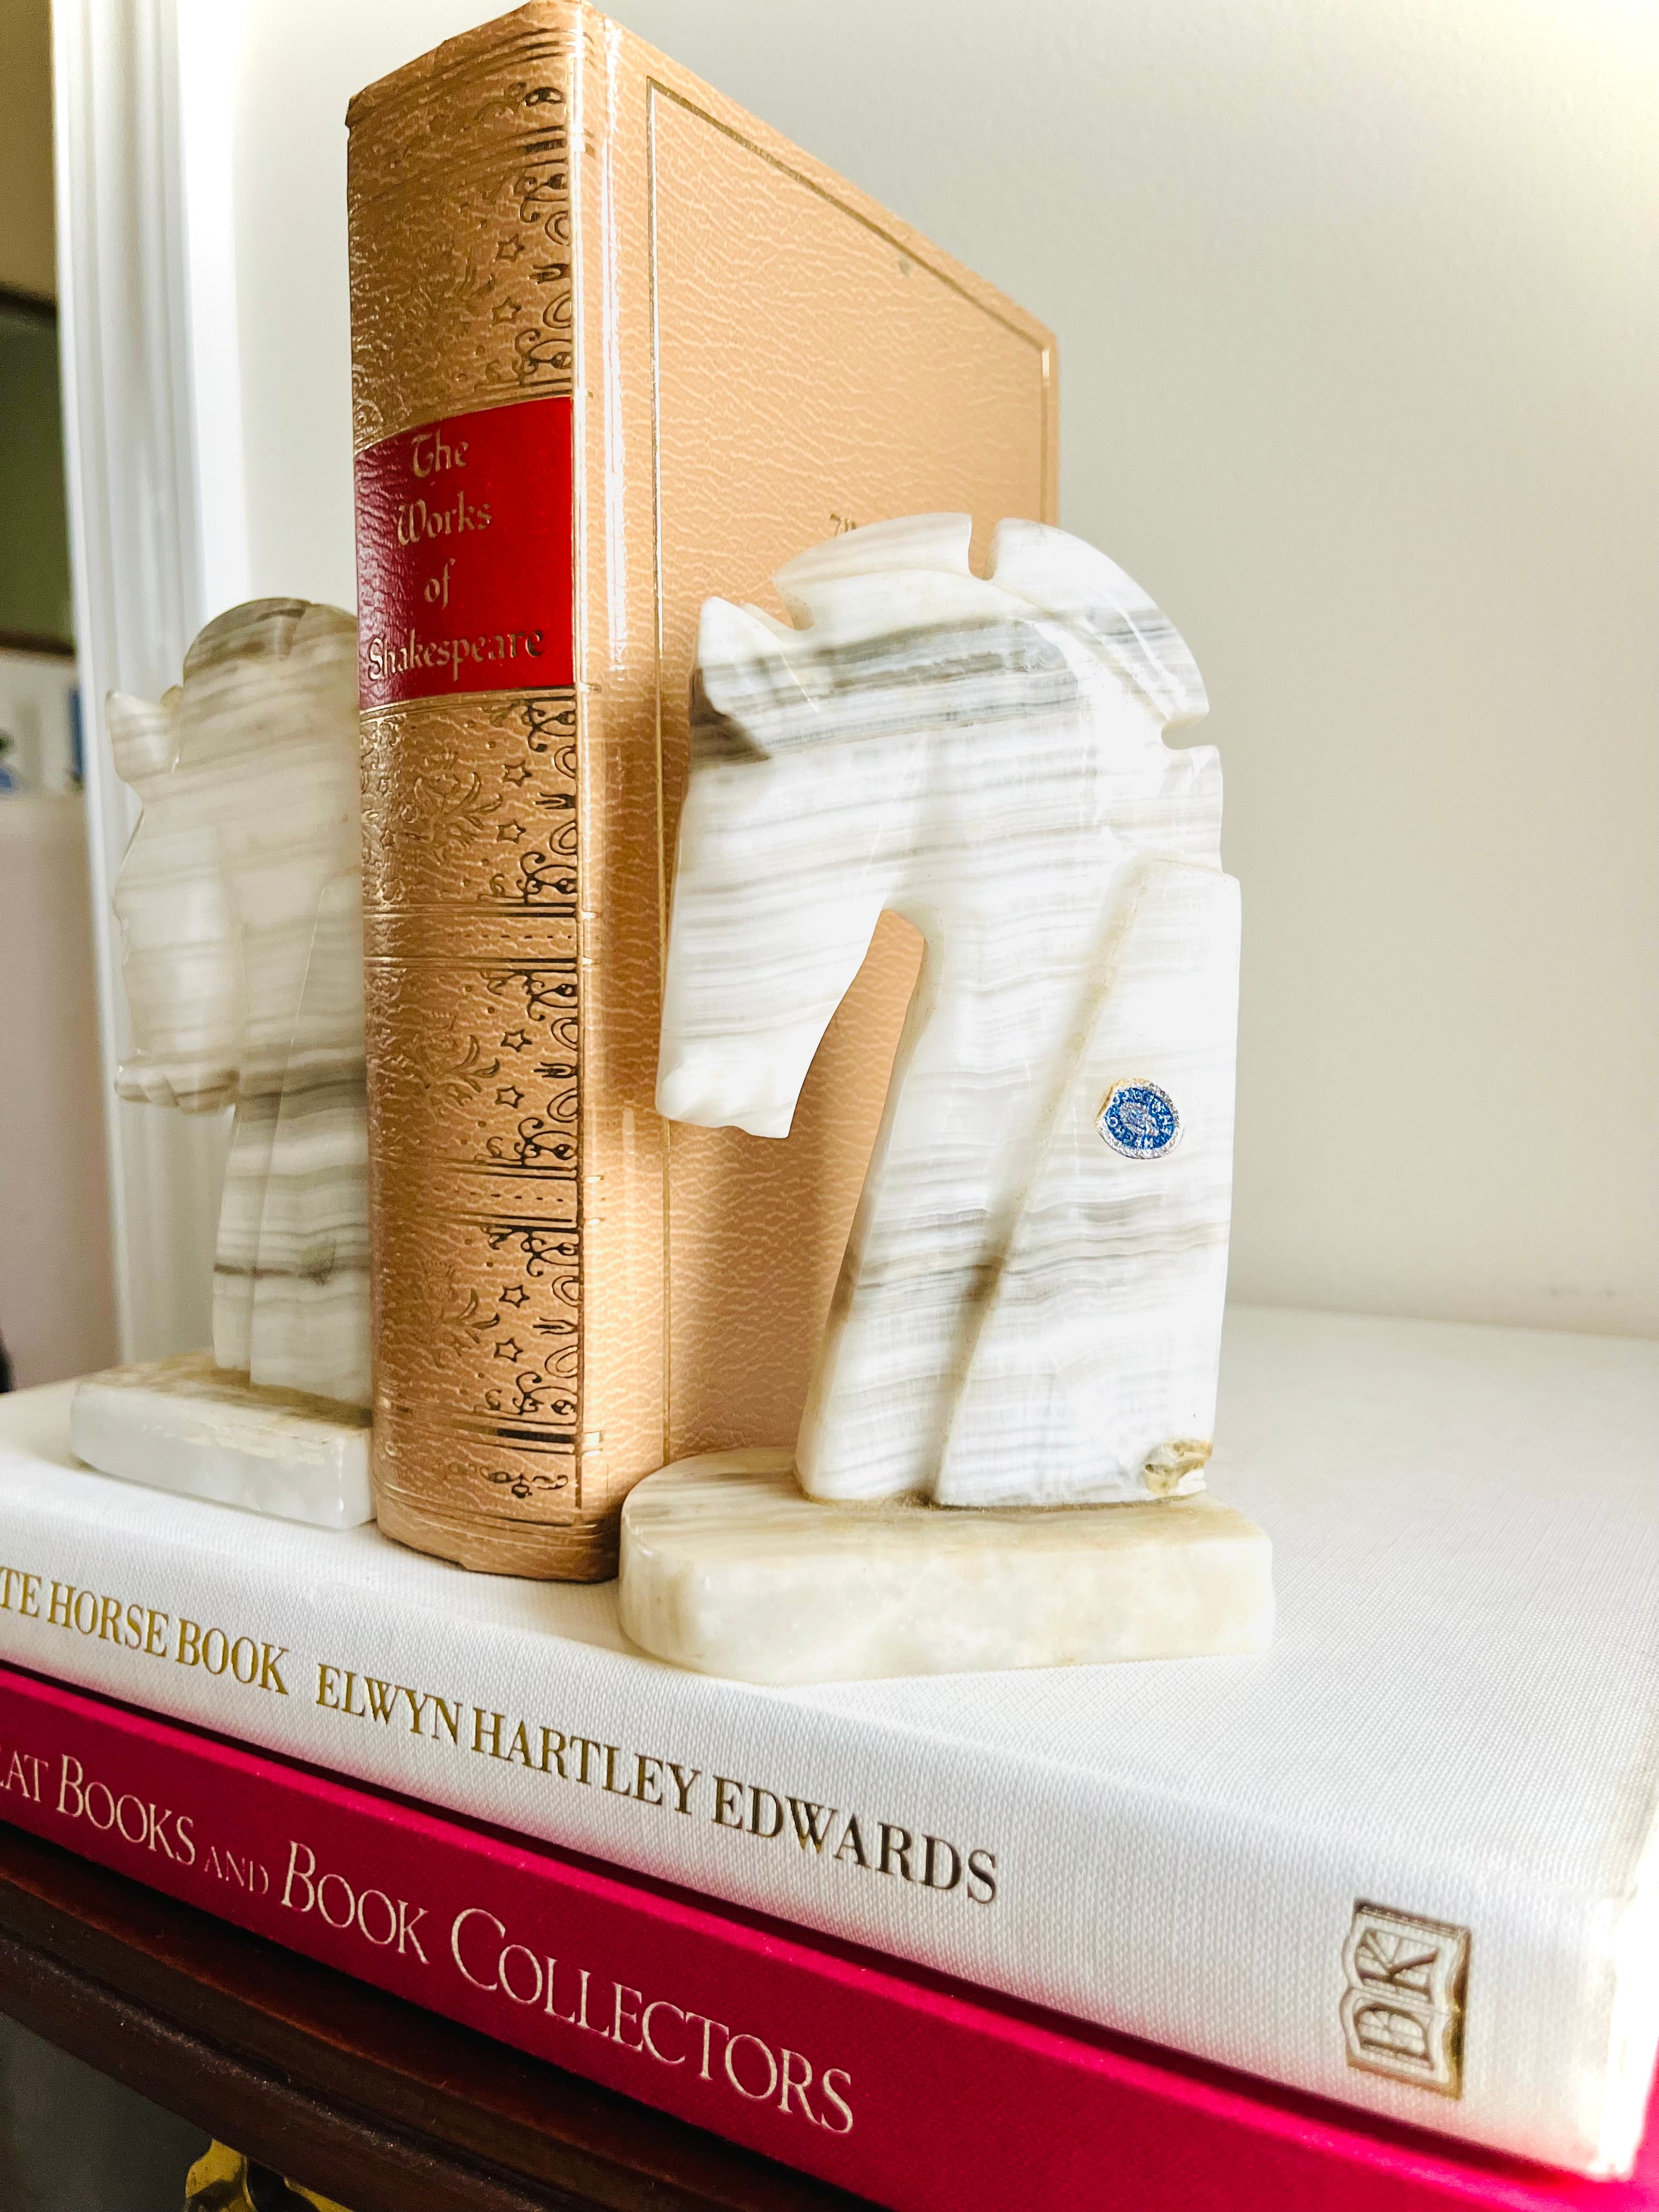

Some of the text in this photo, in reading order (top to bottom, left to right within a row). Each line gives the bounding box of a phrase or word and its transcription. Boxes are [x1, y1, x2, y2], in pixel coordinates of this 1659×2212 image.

[412, 427, 469, 478] The
[397, 491, 493, 546] Works
[424, 557, 456, 611] of
[368, 629, 545, 682] Shakespeare
[47, 1580, 170, 1658] HORSE
[176, 1618, 290, 1696] BOOK
[316, 1663, 463, 1746] ELWYN
[470, 1706, 702, 1816] HARTLEY
[711, 1774, 998, 1904] EDWARDS
[0, 1750, 49, 1803] AT
[204, 1846, 269, 1895] AND
[1351, 1925, 1444, 2075] DK
